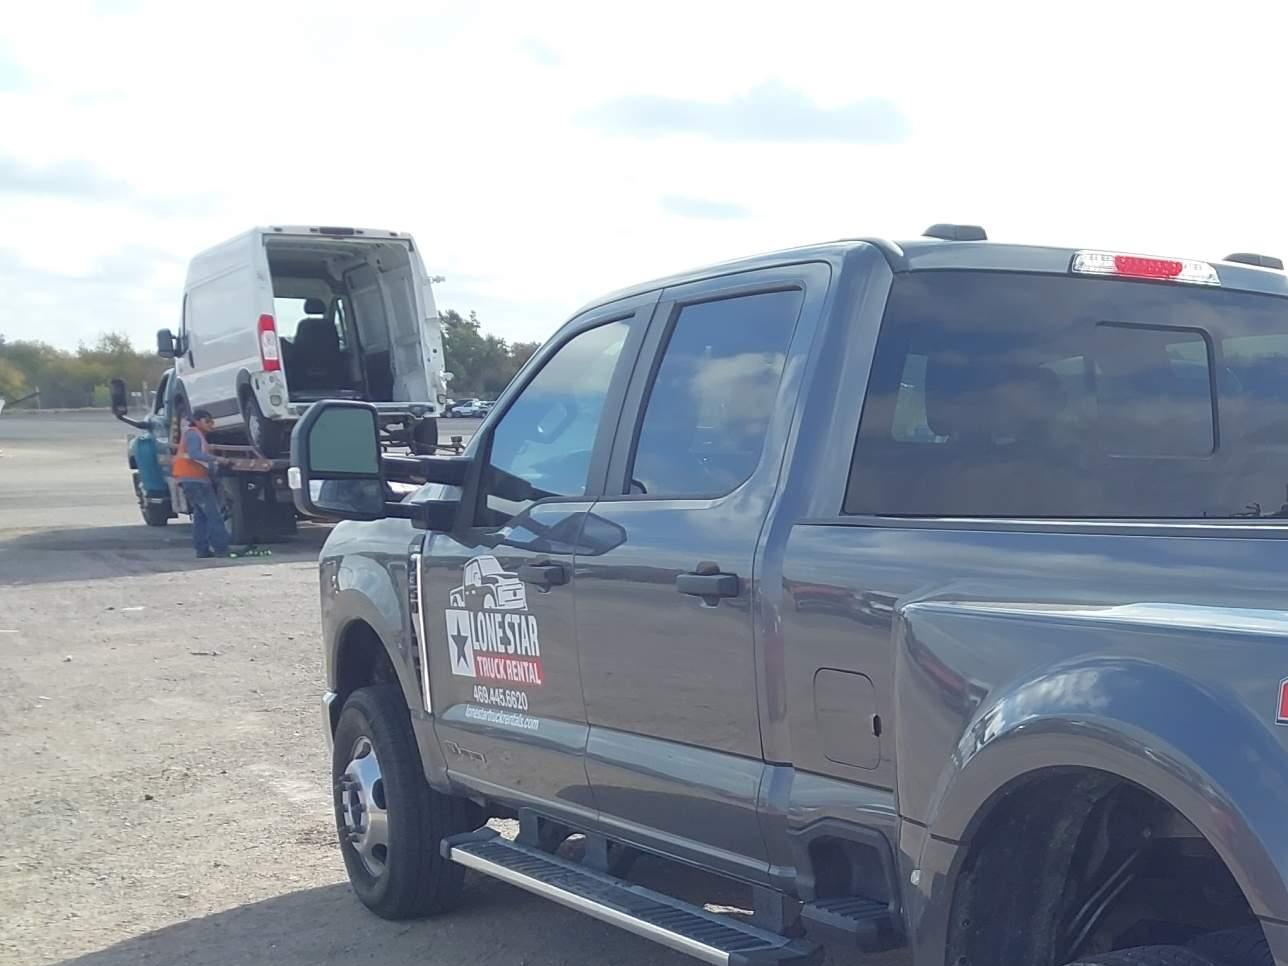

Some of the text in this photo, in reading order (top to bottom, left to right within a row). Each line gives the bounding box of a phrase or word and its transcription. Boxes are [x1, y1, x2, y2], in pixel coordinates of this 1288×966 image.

[470, 611, 540, 656] LONE STAR
[477, 656, 541, 684] TRUCK RENTAL
[473, 685, 528, 710] 469.445.6620
